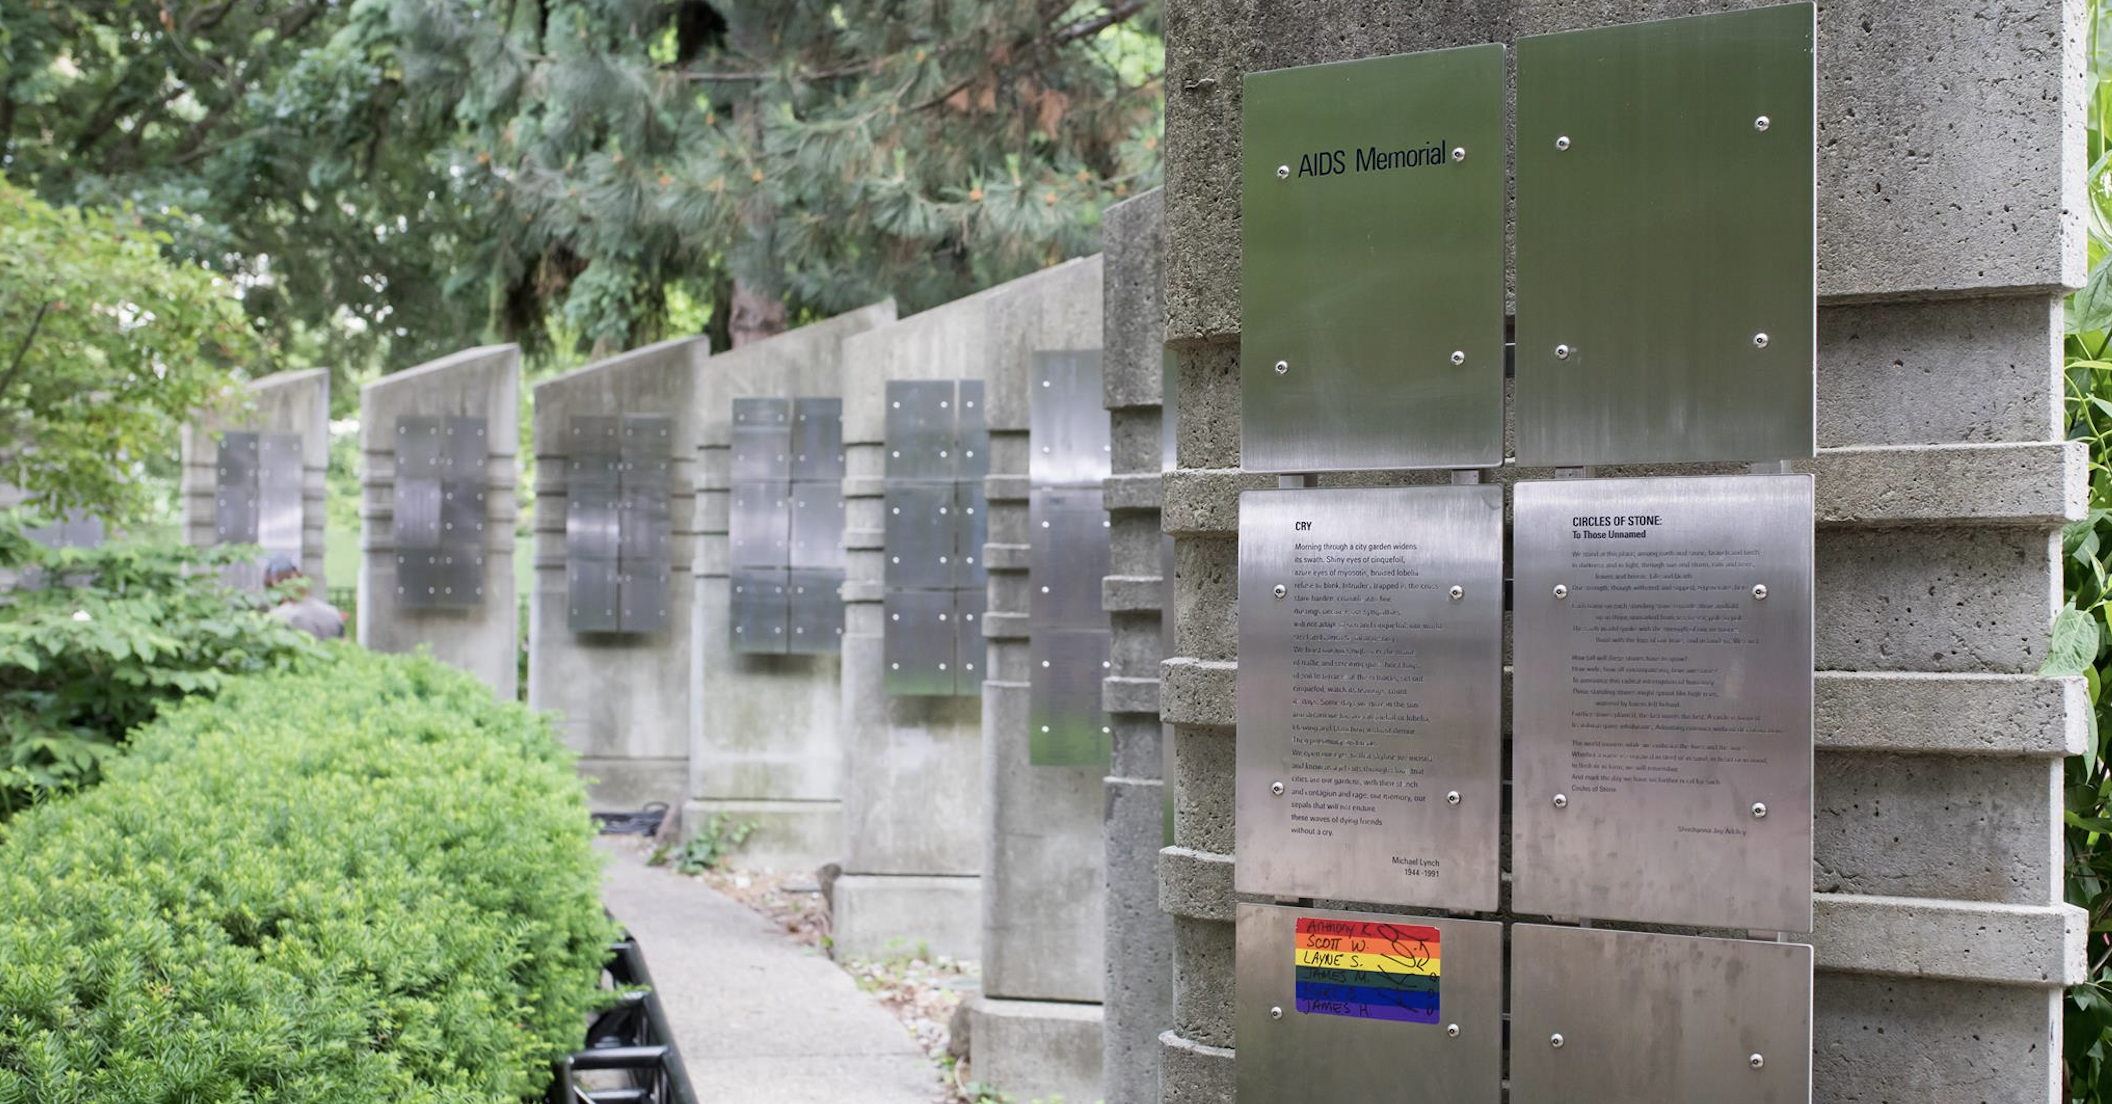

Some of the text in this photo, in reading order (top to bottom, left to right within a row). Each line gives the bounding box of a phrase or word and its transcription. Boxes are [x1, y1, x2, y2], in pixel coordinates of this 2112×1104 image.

[1299, 140, 1446, 178] AIDS Memorial
[1572, 515, 1662, 527] CIRCLES OF STONE:
[1295, 521, 1312, 531] CRY
[1572, 530, 1646, 539] To Those Unnamed
[1295, 543, 1322, 552] Morning
[1323, 543, 1348, 552] through
[1355, 543, 1366, 551] city
[1368, 543, 1392, 552] garden
[1326, 556, 1344, 564] Shiny
[1374, 582, 1399, 590] trapped
[1396, 780, 1418, 788] stnch
[1338, 790, 1351, 798] and
[1292, 802, 1312, 810] sepals
[1313, 802, 1326, 810] that
[1340, 816, 1358, 825] dying
[1291, 826, 1315, 835] without
[1392, 856, 1440, 867] Michael Lynch
[1404, 868, 1419, 876] 1944
[1306, 934, 1369, 952] SCOTT W.
[1304, 950, 1364, 968] LAYNE S.
[1302, 970, 1370, 984] JAMES M.
[1304, 1000, 1350, 1015] JAMES
